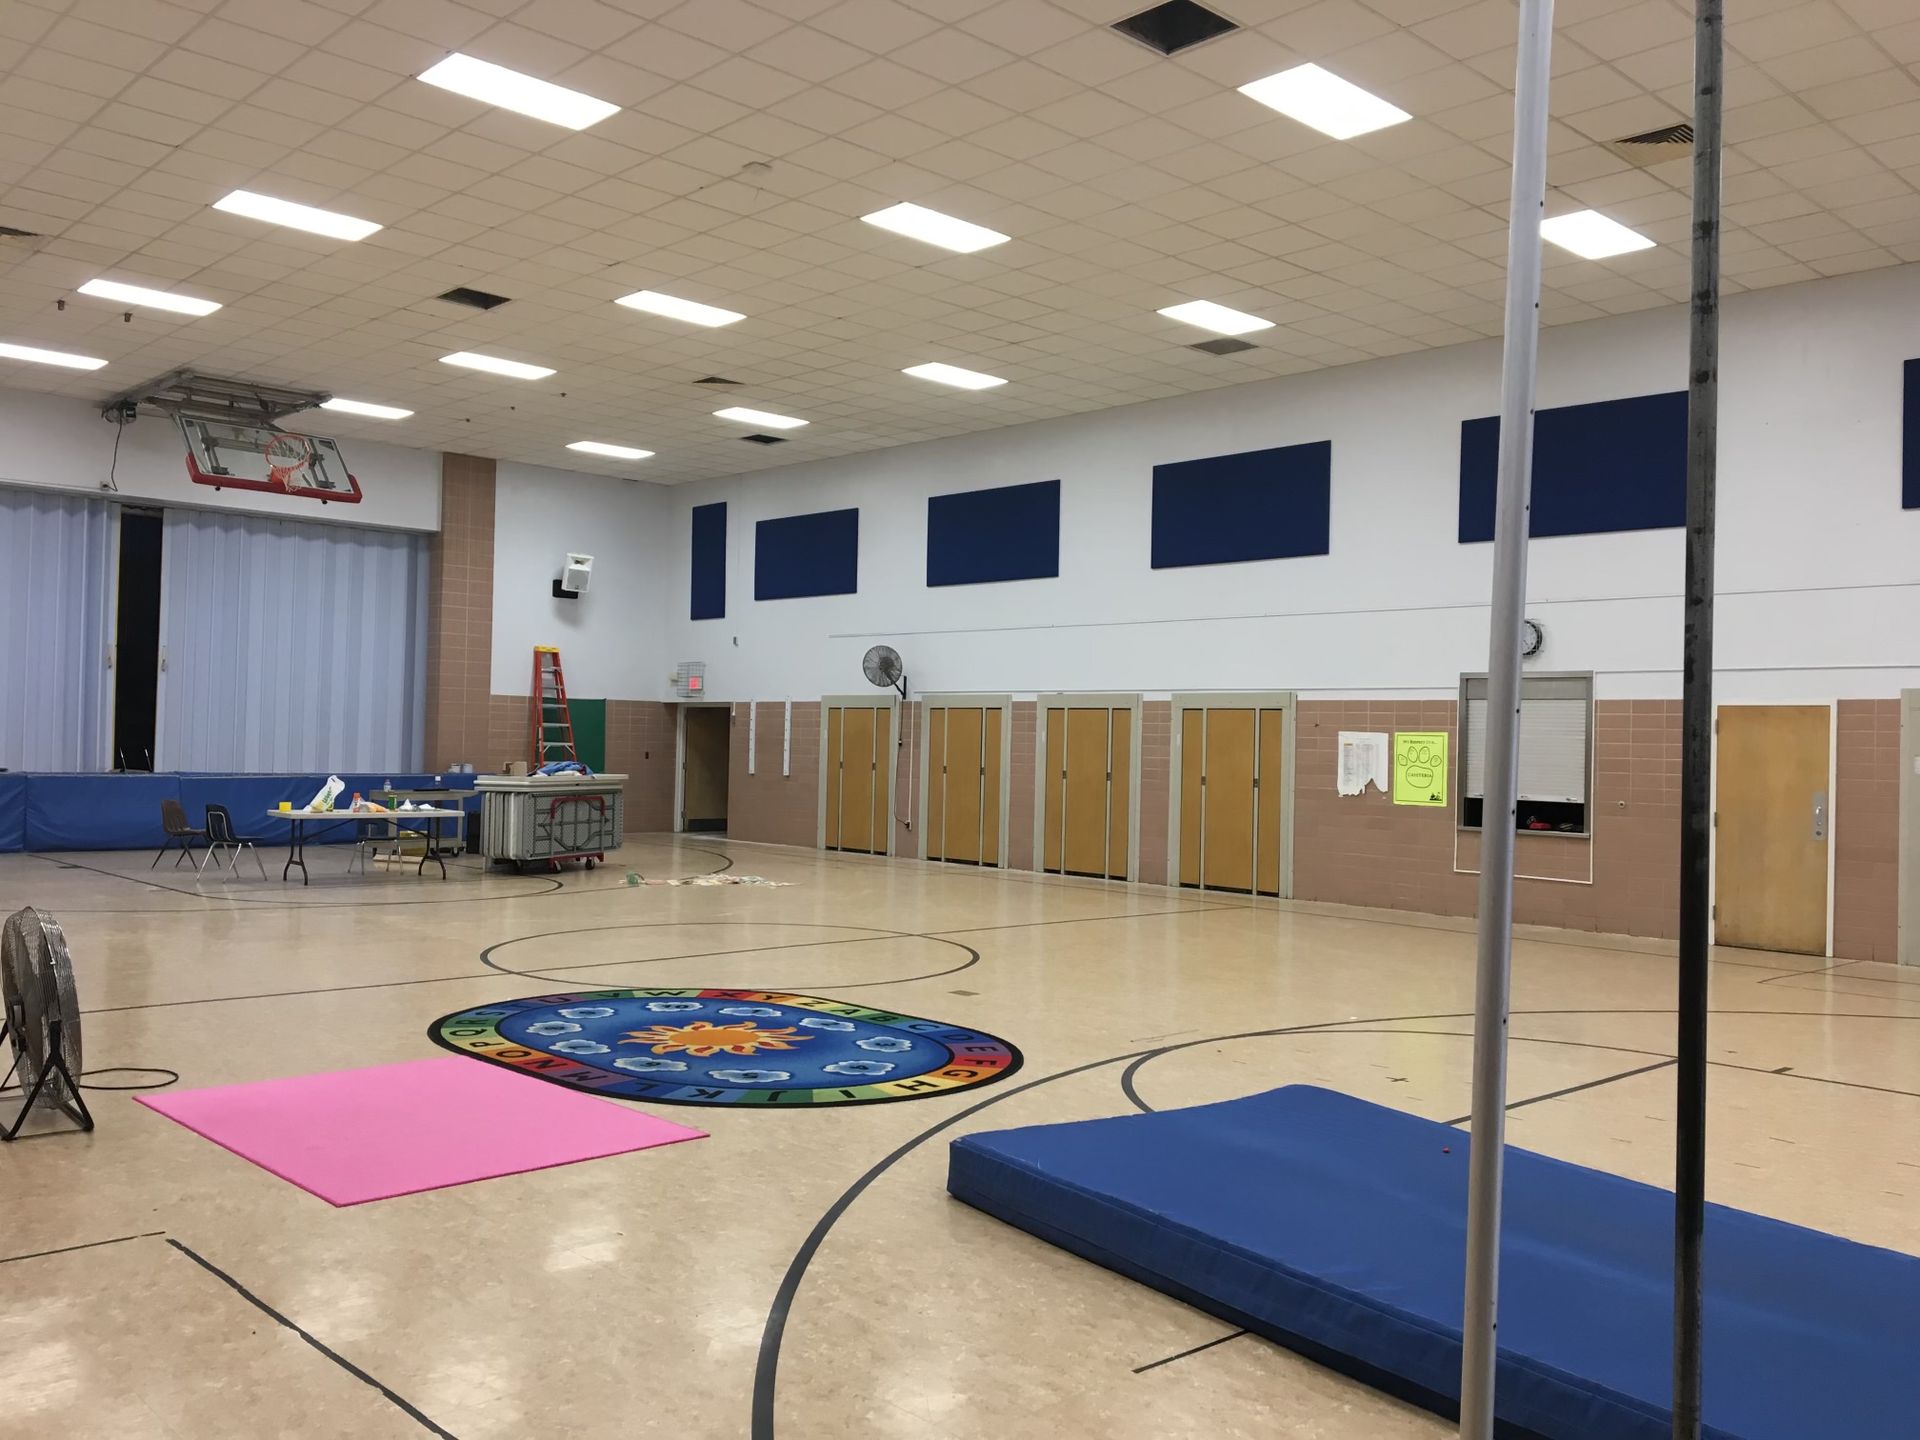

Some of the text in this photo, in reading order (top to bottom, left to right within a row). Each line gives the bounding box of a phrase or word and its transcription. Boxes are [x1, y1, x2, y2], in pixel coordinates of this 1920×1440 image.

[830, 1008, 862, 1016] A
[908, 1023, 940, 1031] C
[449, 1028, 487, 1036] Q
[496, 1050, 532, 1058] O
[524, 1059, 568, 1069] N
[964, 1057, 997, 1066] F
[562, 1071, 609, 1082] M
[943, 1069, 978, 1078] G
[635, 1081, 660, 1091] L
[893, 1080, 940, 1091] H
[688, 1088, 725, 1098] K
[838, 1089, 857, 1098] I
